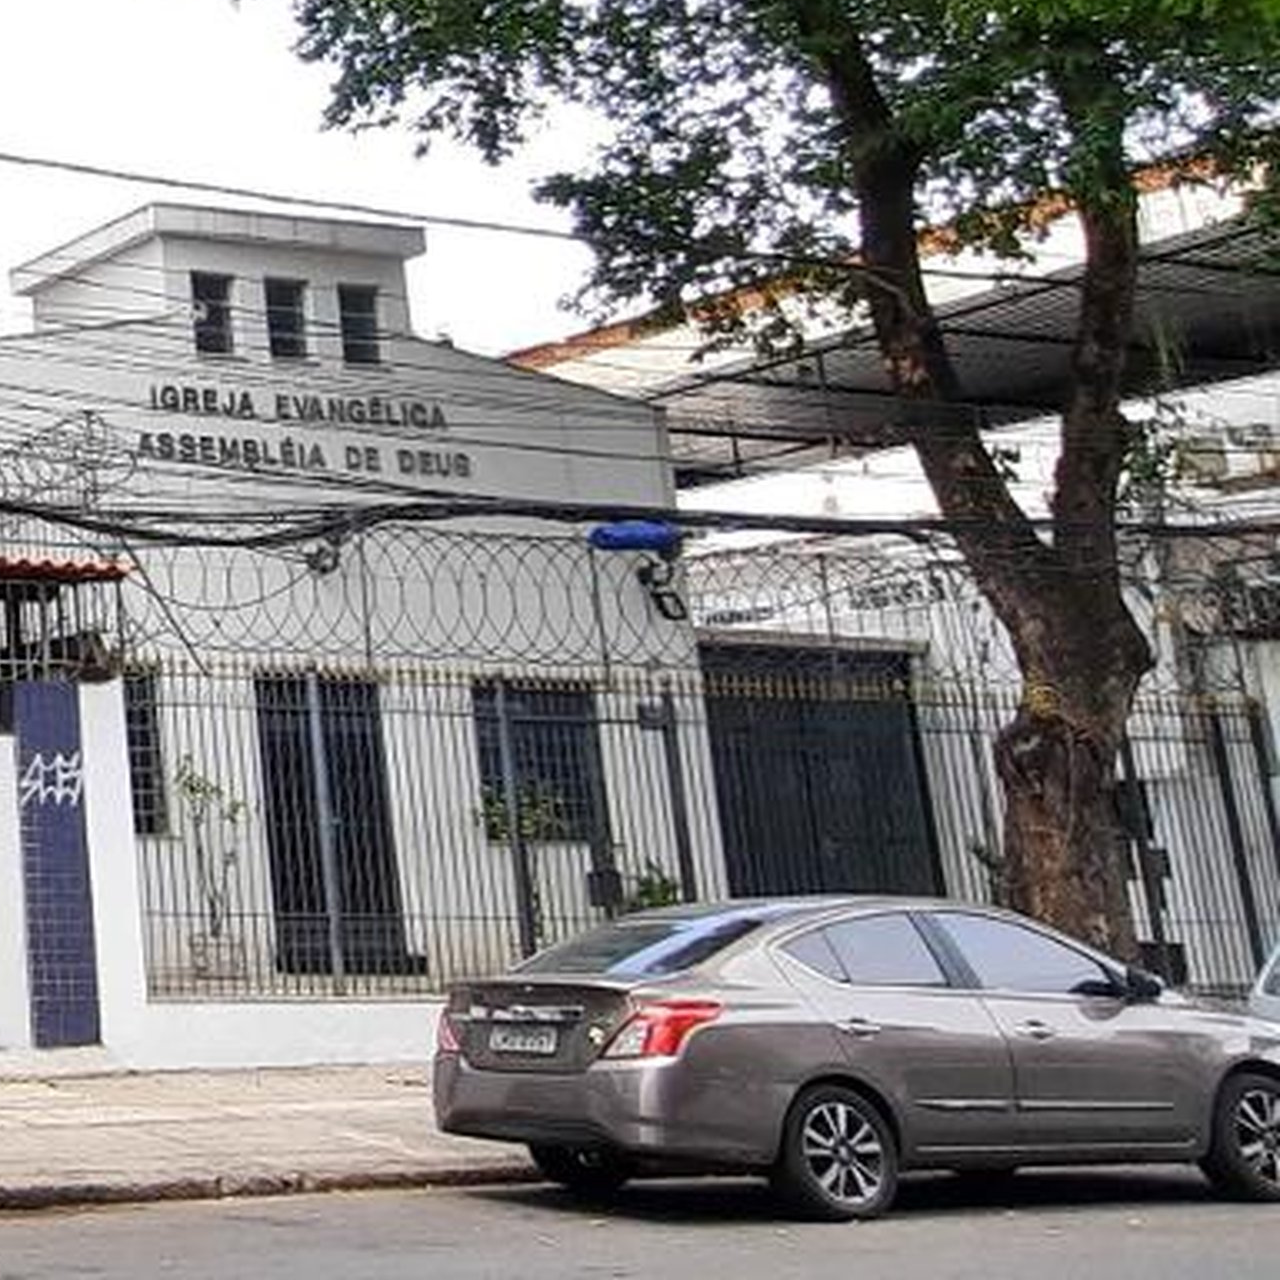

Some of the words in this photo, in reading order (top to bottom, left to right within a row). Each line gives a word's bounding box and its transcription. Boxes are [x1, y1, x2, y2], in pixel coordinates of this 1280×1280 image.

[150, 384, 258, 419] IGREJA
[276, 394, 448, 430] EVANGÉLICA
[139, 431, 326, 469] ASSEMBLÉIA
[345, 445, 381, 471] DE
[397, 448, 471, 478] DEUS
